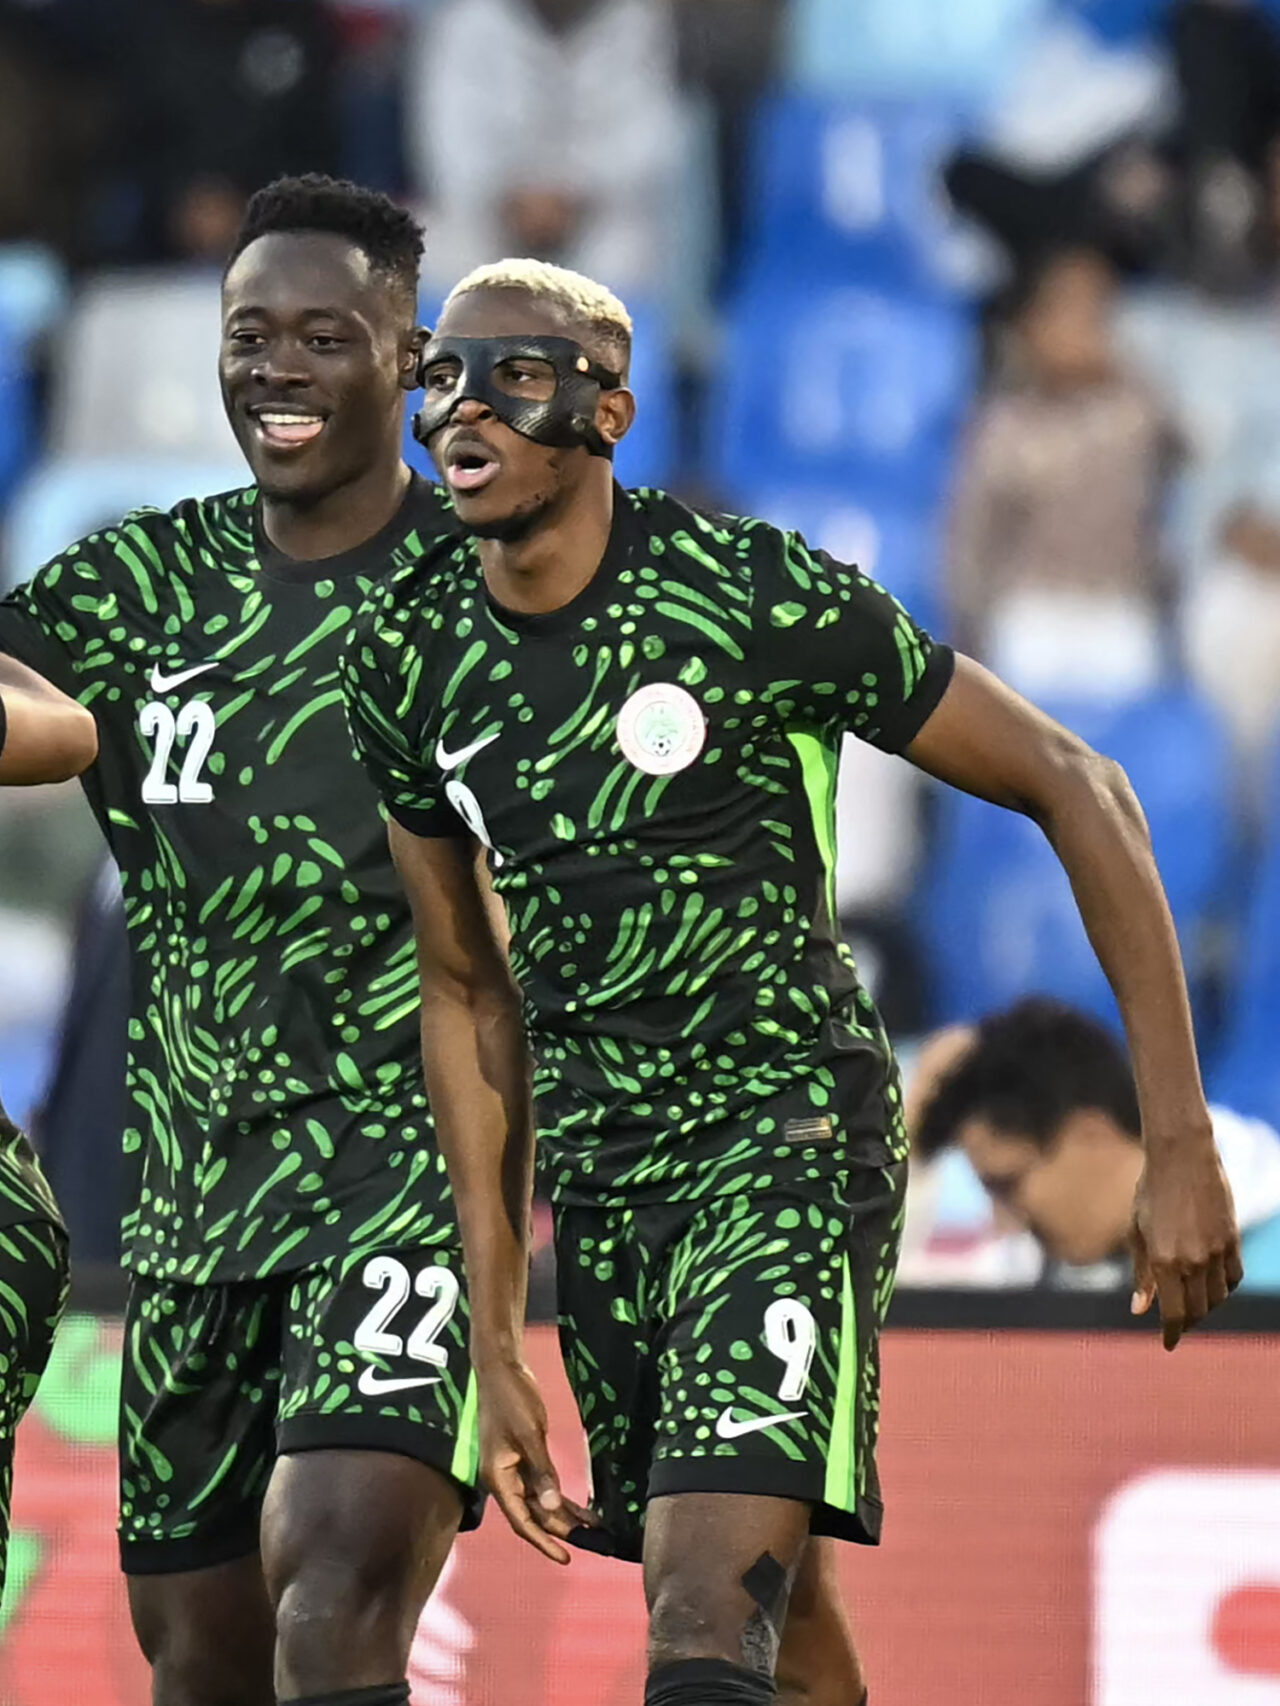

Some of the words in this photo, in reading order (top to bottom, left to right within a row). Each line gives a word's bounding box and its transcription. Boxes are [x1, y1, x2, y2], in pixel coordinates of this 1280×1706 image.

[139, 701, 216, 804] 22
[353, 1255, 460, 1368] 22
[764, 1298, 816, 1401] 9
